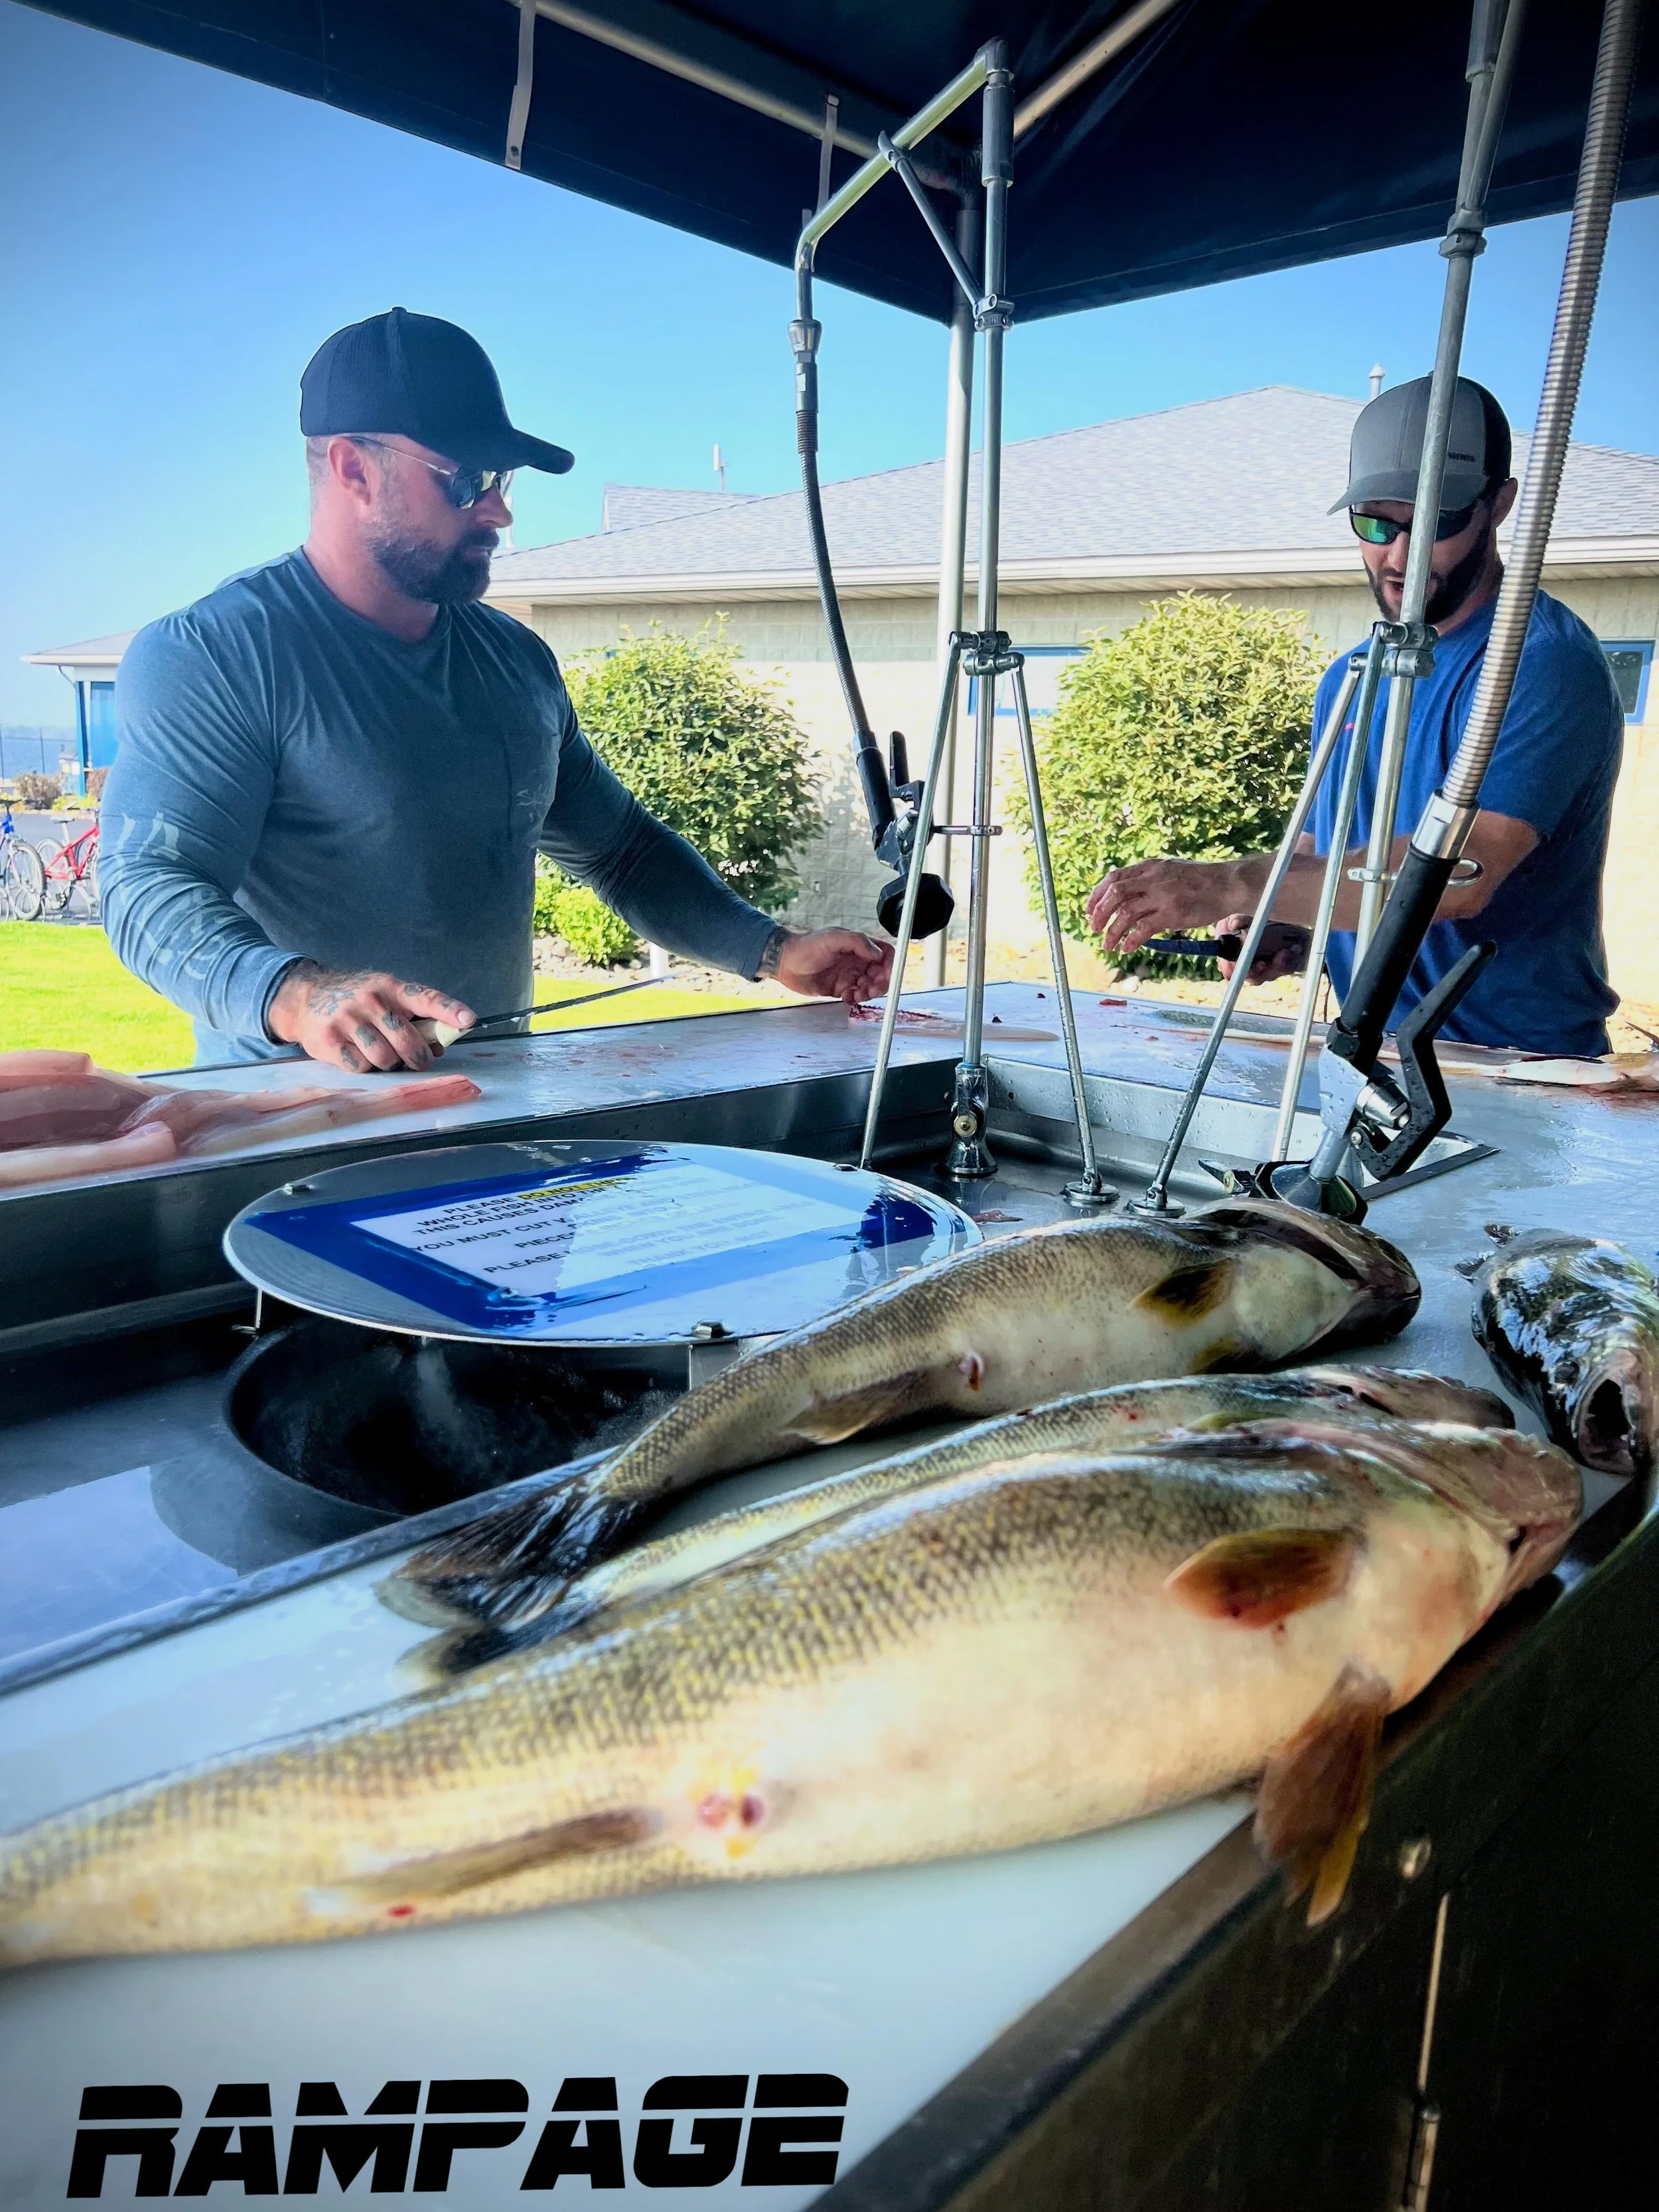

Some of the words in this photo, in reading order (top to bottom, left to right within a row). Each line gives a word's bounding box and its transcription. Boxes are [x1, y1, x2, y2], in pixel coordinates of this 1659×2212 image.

[415, 1209, 492, 1226] WHOLE
[490, 1201, 534, 1212] FISH
[533, 1193, 578, 1203] INTO
[442, 1197, 518, 1213] PLEASE
[545, 1185, 584, 1195] NOT
[411, 1223, 462, 1234] THIS
[460, 1208, 540, 1226] CAUSES
[408, 1240, 457, 1252] YOU
[455, 1228, 514, 1243] MUST
[512, 1221, 555, 1231] CUT
[513, 1231, 585, 1248] PIECES
[482, 1252, 567, 1272] PLEASE
[66, 2073, 849, 2198] RAMPAGE
